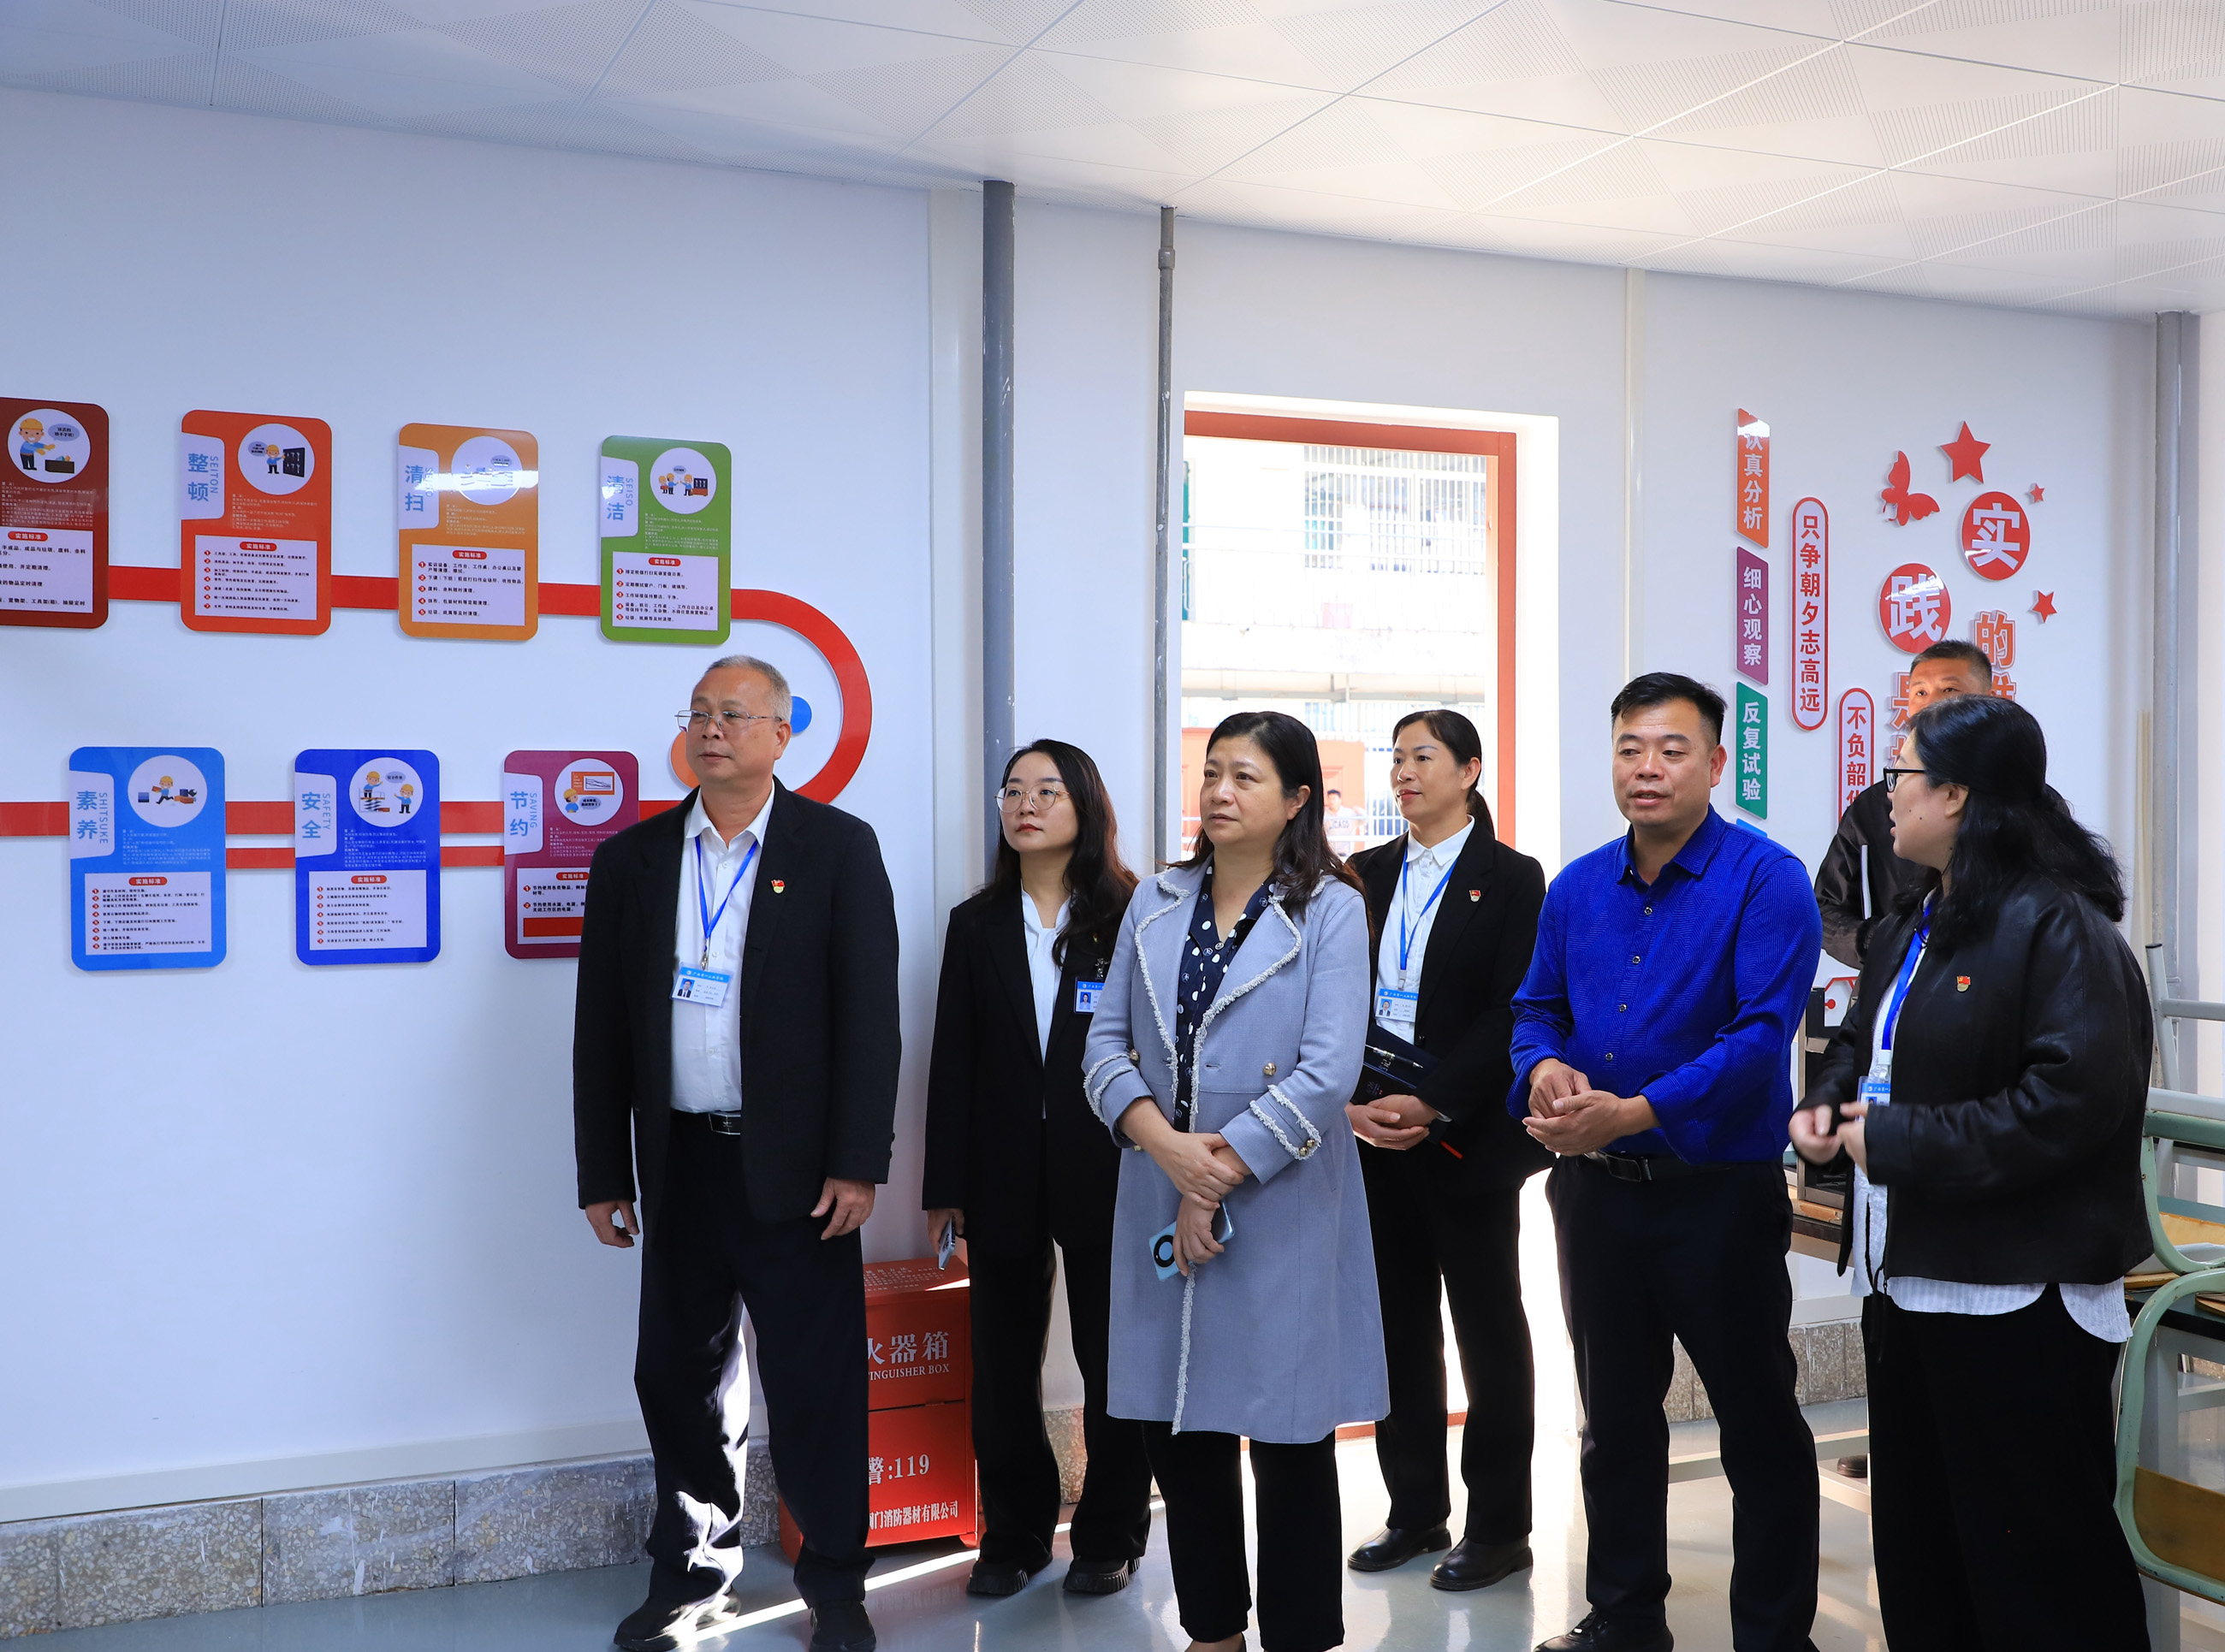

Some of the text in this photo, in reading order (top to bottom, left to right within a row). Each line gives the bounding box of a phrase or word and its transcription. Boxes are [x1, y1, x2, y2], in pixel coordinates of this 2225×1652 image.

[187, 452, 210, 502] 整顿
[211, 455, 219, 494] SEITON
[405, 465, 424, 512] 清扫
[606, 475, 625, 521] 清洁
[1743, 434, 1763, 530] 认真分析
[1742, 565, 1763, 666] 细心观察
[1800, 514, 1821, 713] 只争朝夕志高远
[1741, 701, 1762, 801] 反复试验
[76, 790, 98, 840] 素养
[98, 792, 109, 844] SHITSUKE
[301, 791, 321, 839] 安全
[323, 793, 331, 830] SAFETY
[510, 790, 529, 837] 节约
[529, 792, 537, 828] SAVING
[869, 1363, 950, 1381] INGUISHER BOX
